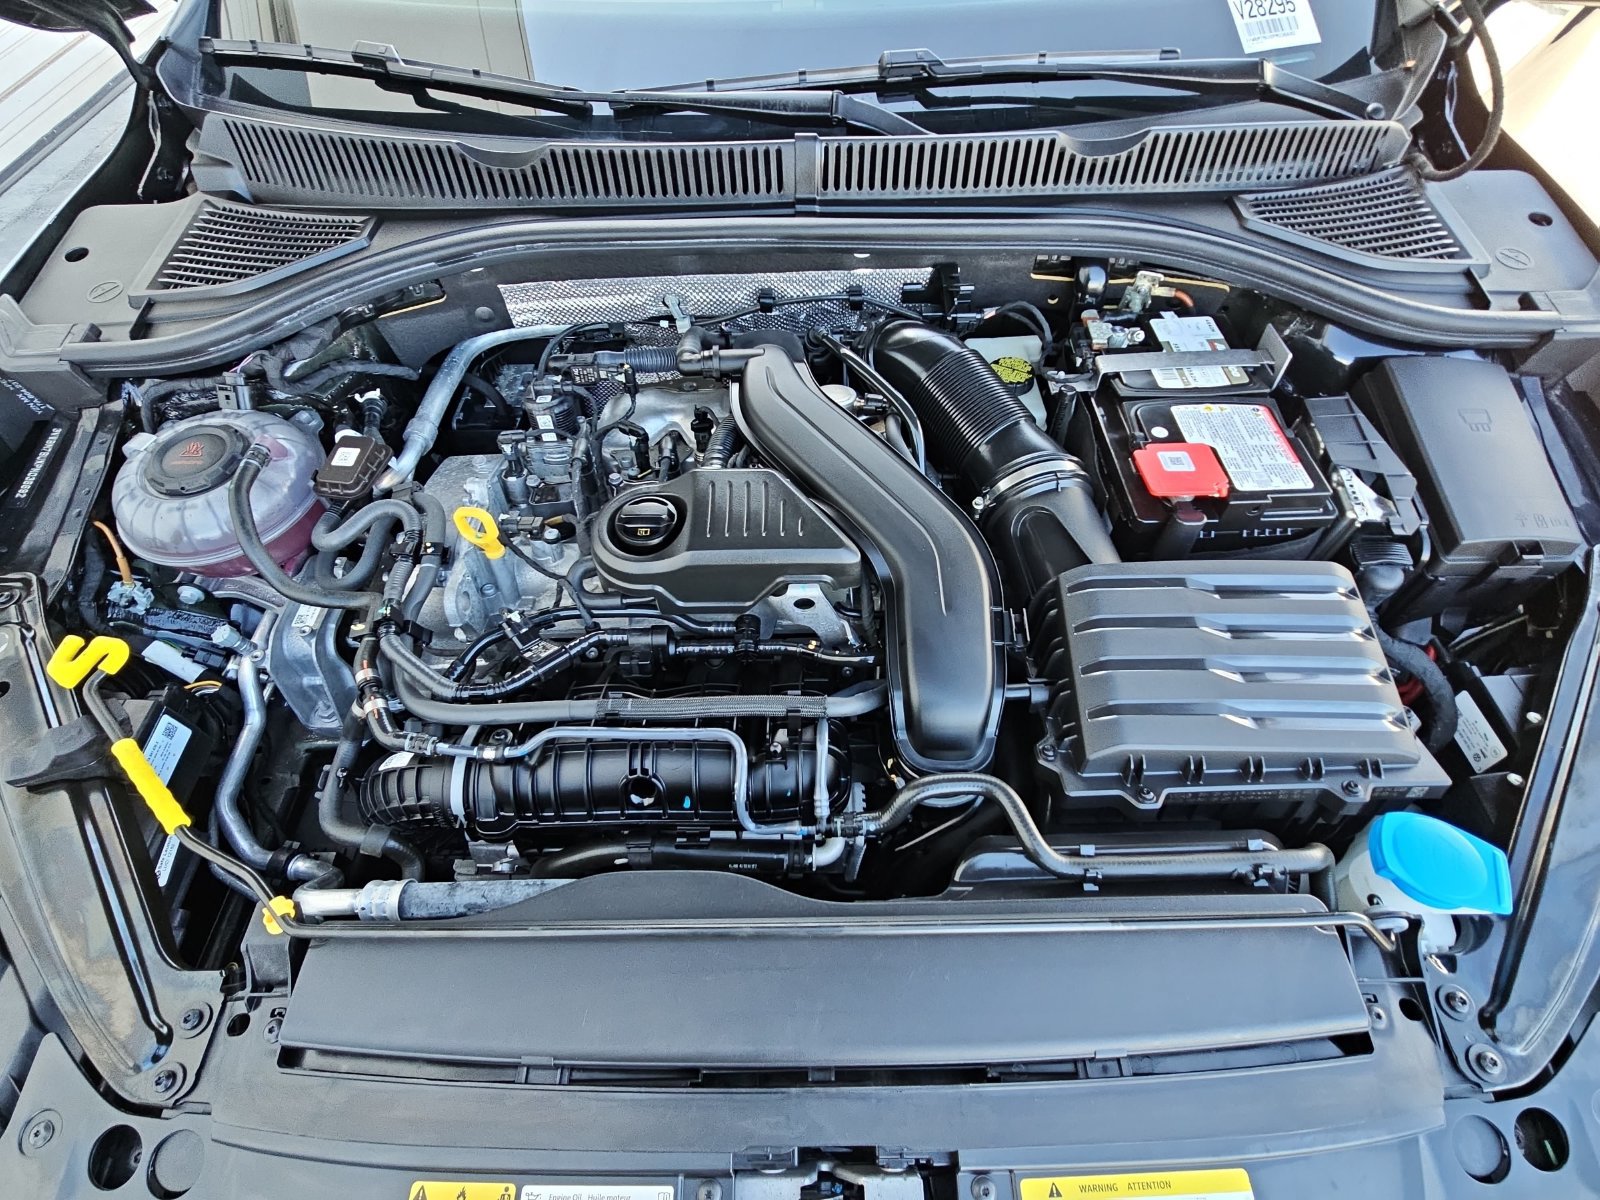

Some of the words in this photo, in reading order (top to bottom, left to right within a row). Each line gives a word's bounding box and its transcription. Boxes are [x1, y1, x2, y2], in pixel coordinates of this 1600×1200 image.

[1233, 0, 1296, 19] V28295
[1078, 1182, 1118, 1193] WARNING
[1127, 1180, 1172, 1191] ATTENTION
